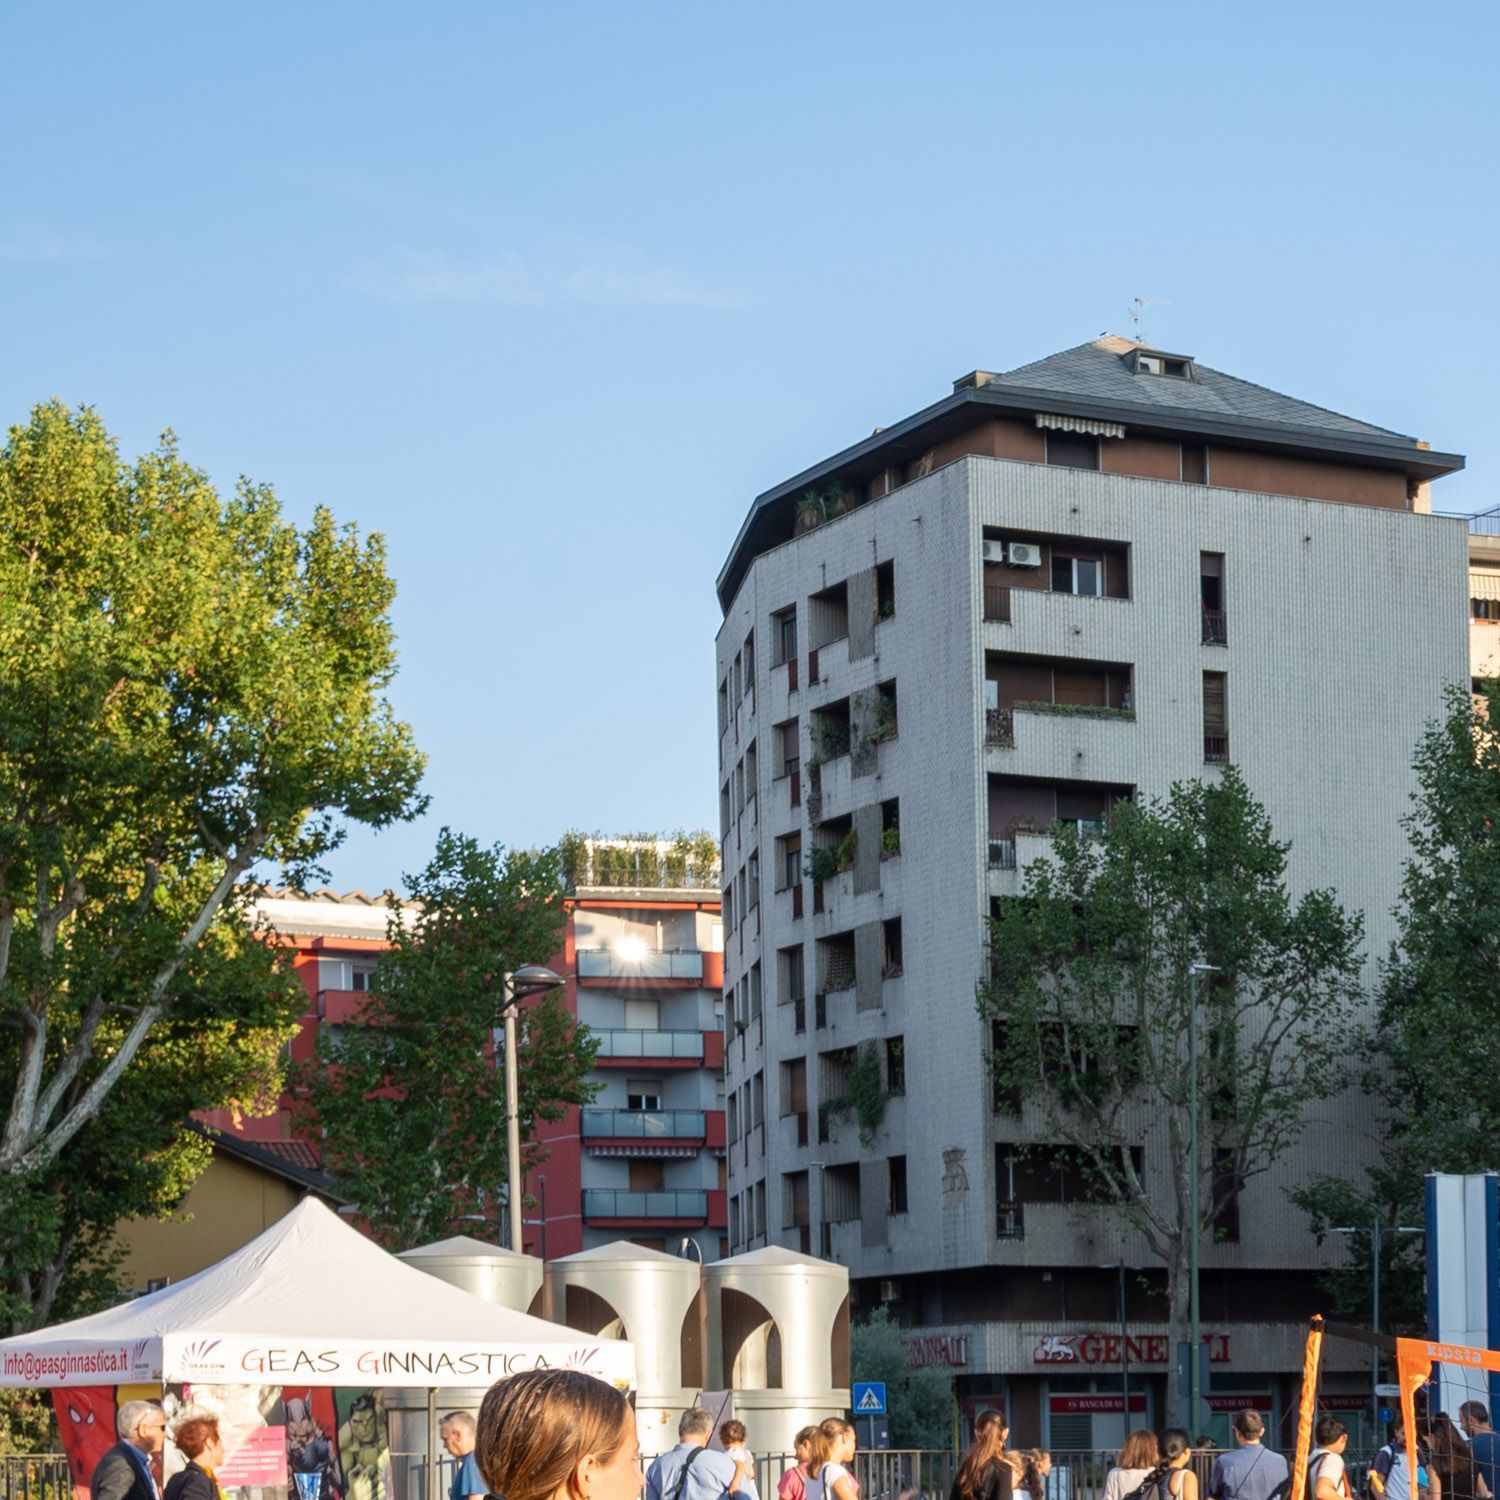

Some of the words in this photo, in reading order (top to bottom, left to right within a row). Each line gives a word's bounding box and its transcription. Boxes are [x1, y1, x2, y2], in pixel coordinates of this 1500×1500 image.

[241, 1349, 340, 1374] GEAS
[357, 1350, 553, 1375] GINNASTICA
[1079, 1335, 1231, 1363] GENELI
[1426, 1343, 1482, 1364] kipsta
[4, 1349, 128, 1380] info@geasginnastica.it
